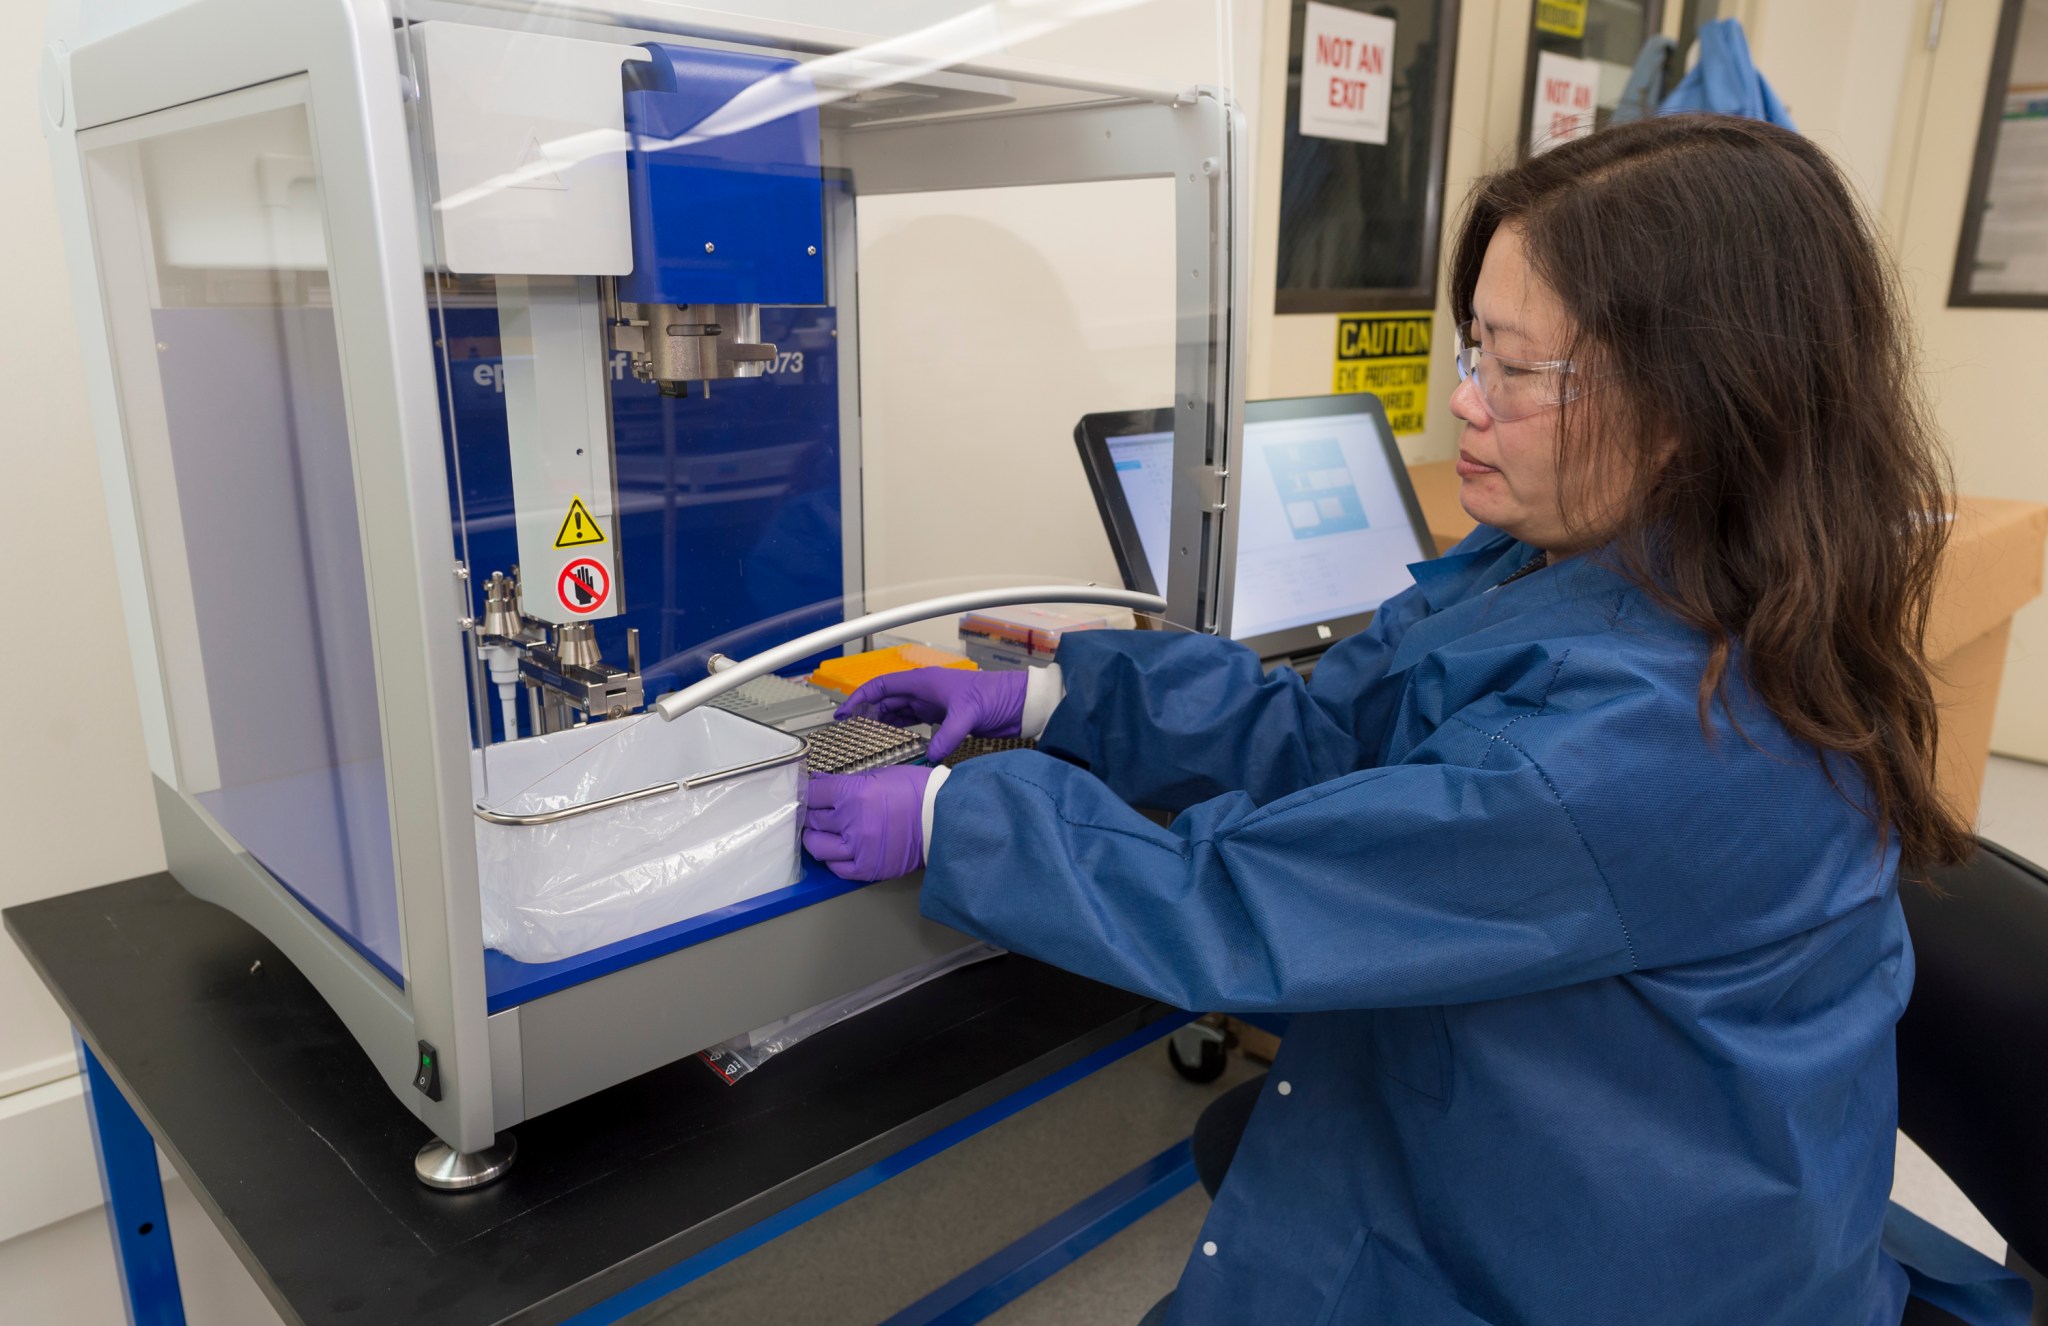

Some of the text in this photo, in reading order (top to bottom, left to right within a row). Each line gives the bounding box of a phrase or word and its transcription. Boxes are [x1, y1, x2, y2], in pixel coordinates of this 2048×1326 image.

[1316, 33, 1384, 76] NOT AN
[1328, 76, 1367, 112] EXIT
[1545, 79, 1591, 109] NOT AN
[1550, 111, 1579, 139] EXIT
[1341, 321, 1429, 356] CAUTION
[761, 351, 804, 373] 073
[1365, 363, 1428, 388] PROTECTION
